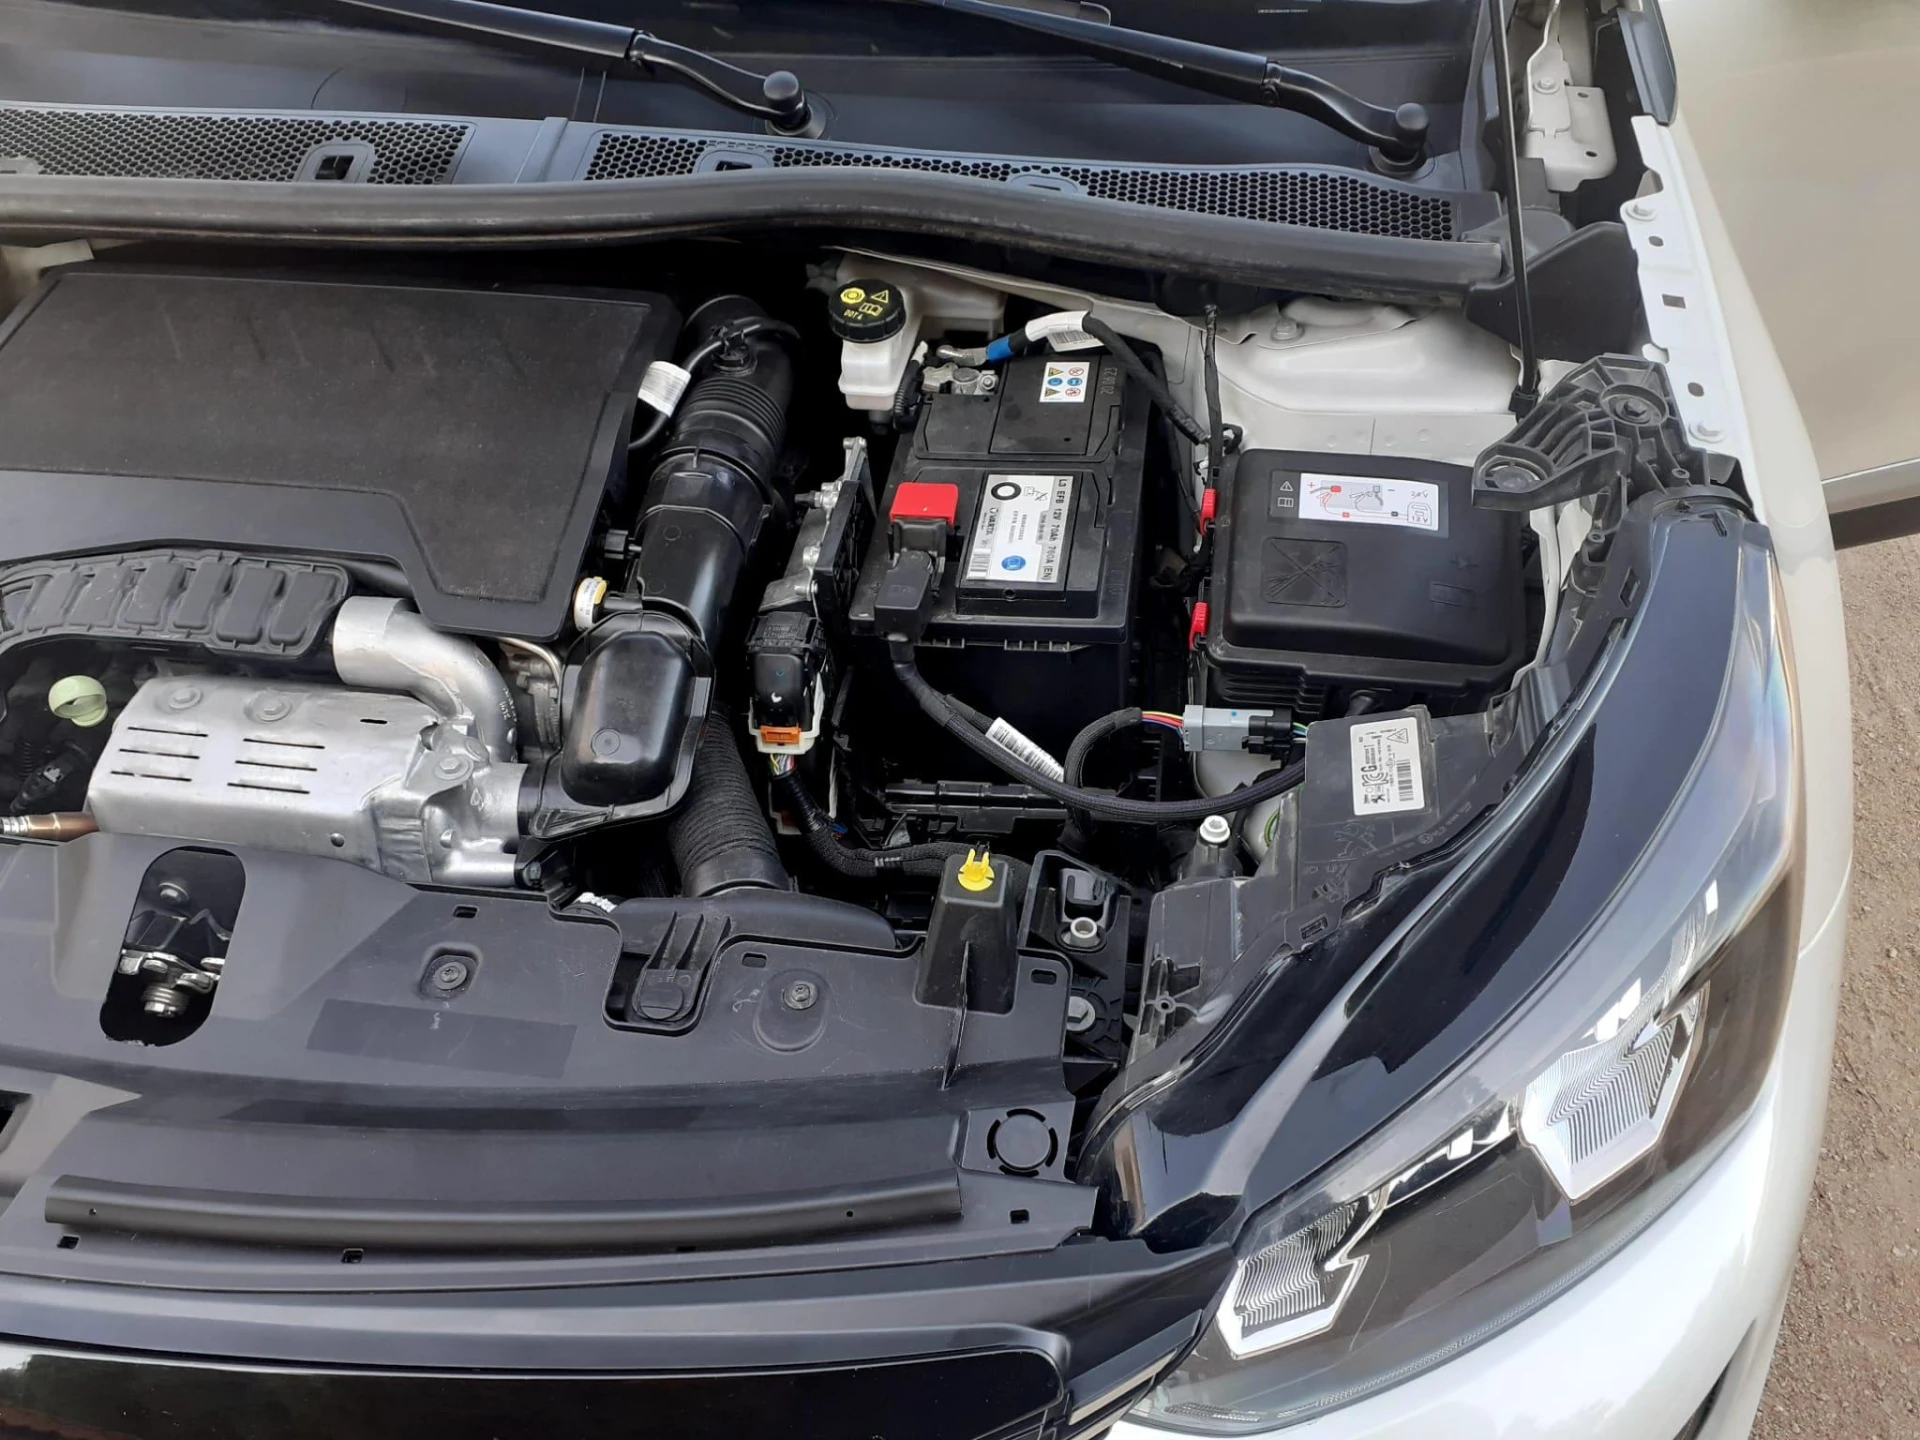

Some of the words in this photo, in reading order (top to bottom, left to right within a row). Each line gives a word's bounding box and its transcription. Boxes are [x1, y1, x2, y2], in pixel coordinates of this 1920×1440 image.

[1058, 478, 1067, 487] L3
[1055, 490, 1066, 504] EFB
[1053, 508, 1063, 521] 12V
[1049, 524, 1060, 542] 70Ah
[1042, 565, 1053, 580] (EN)
